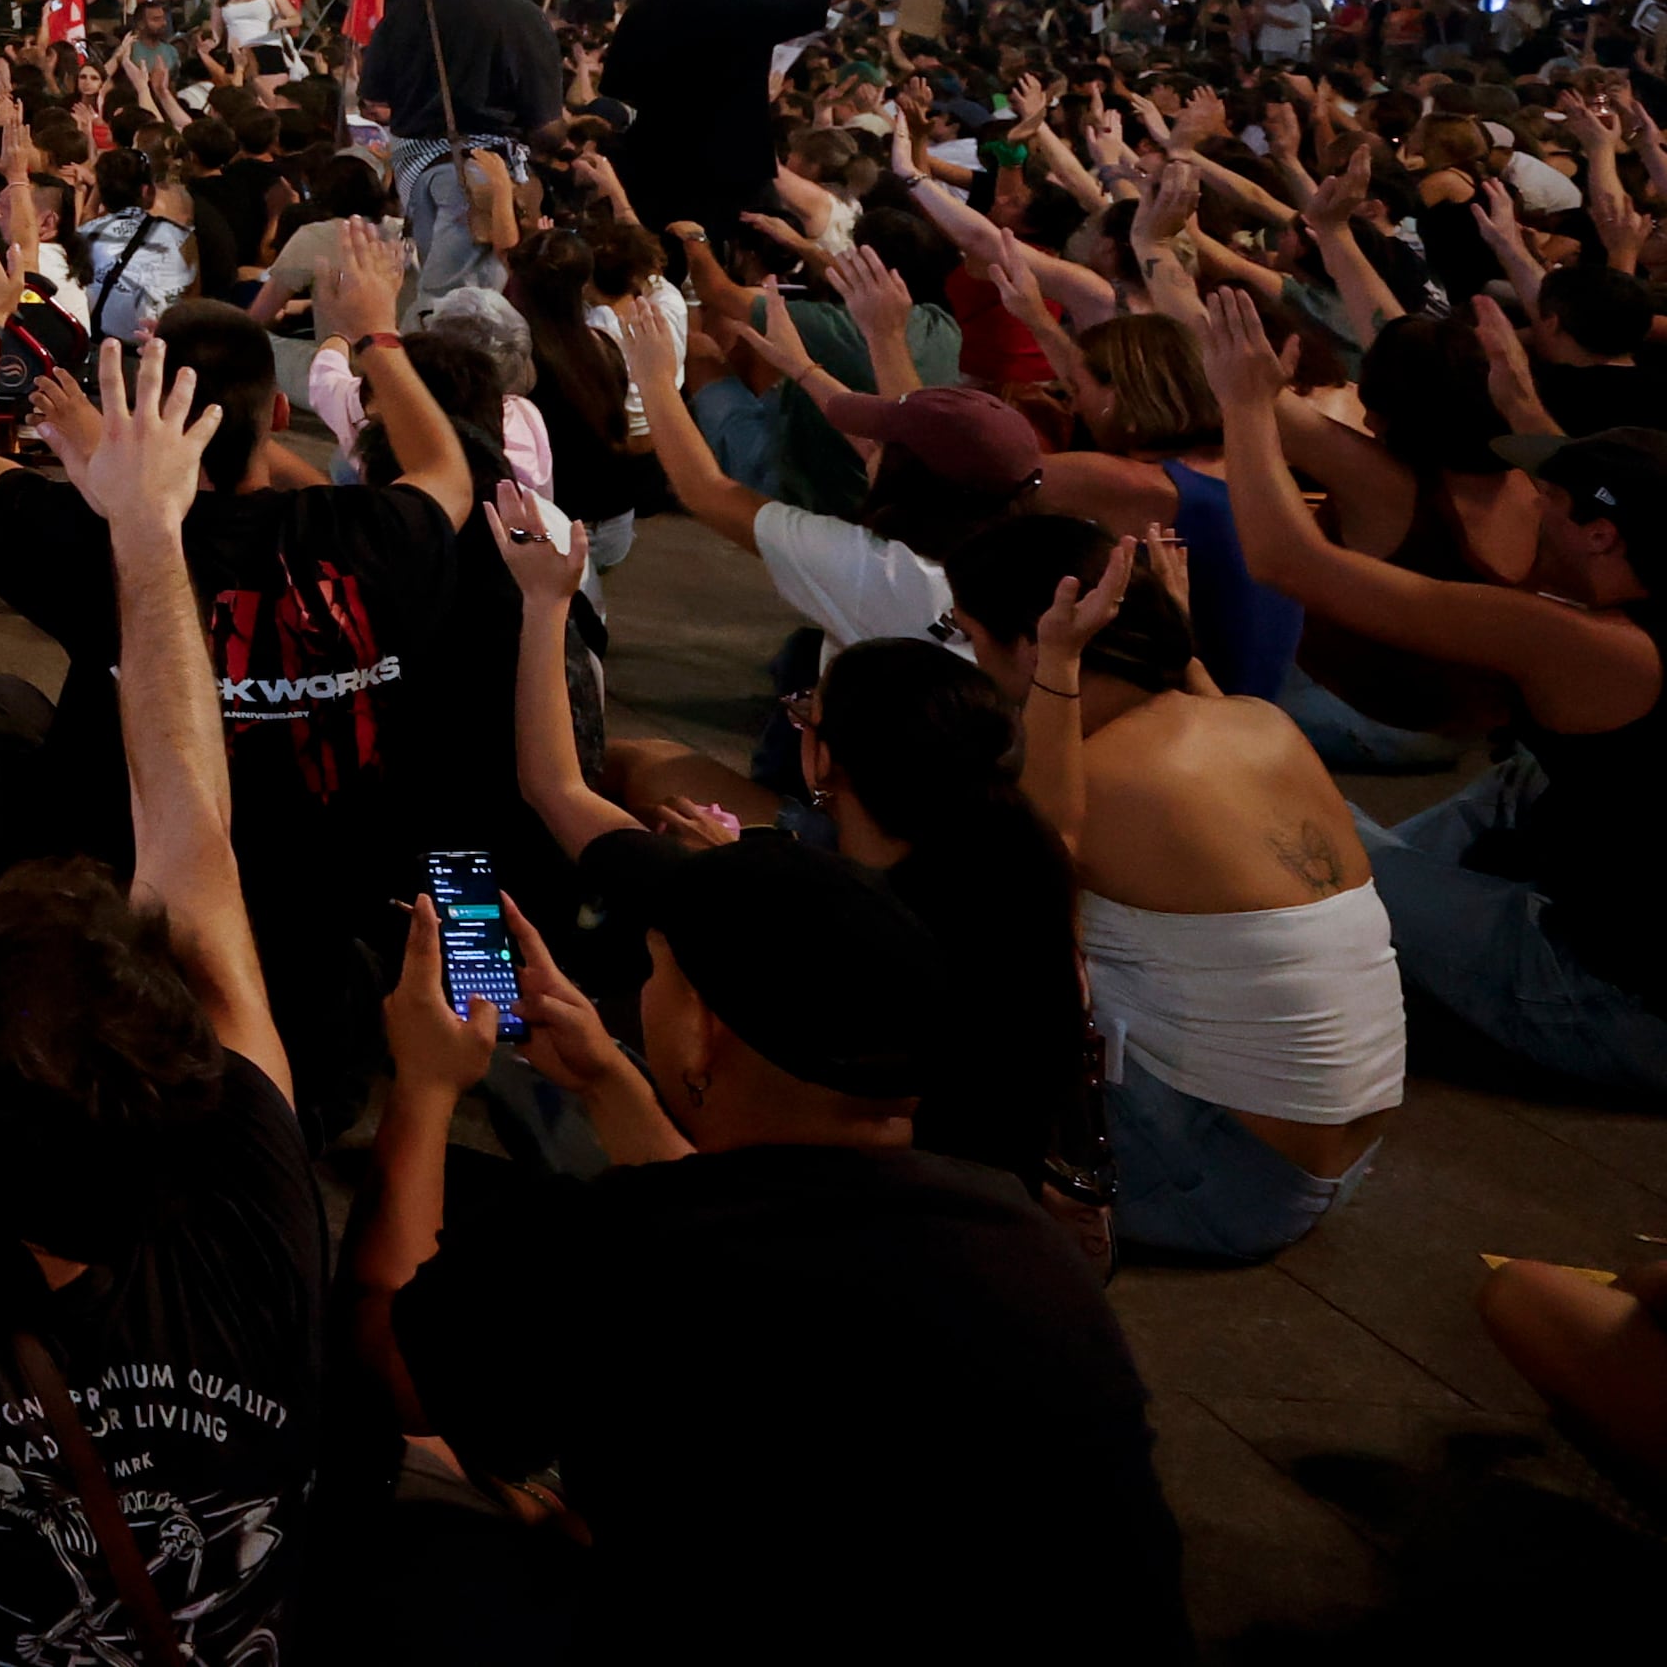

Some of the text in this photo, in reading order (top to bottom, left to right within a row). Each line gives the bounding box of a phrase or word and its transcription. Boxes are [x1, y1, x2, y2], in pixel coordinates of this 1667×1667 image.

[109, 654, 402, 704] KWORKS
[68, 1363, 176, 1415] PRMIUM
[186, 1368, 291, 1431] QUALITY
[133, 1404, 228, 1445] LIVING
